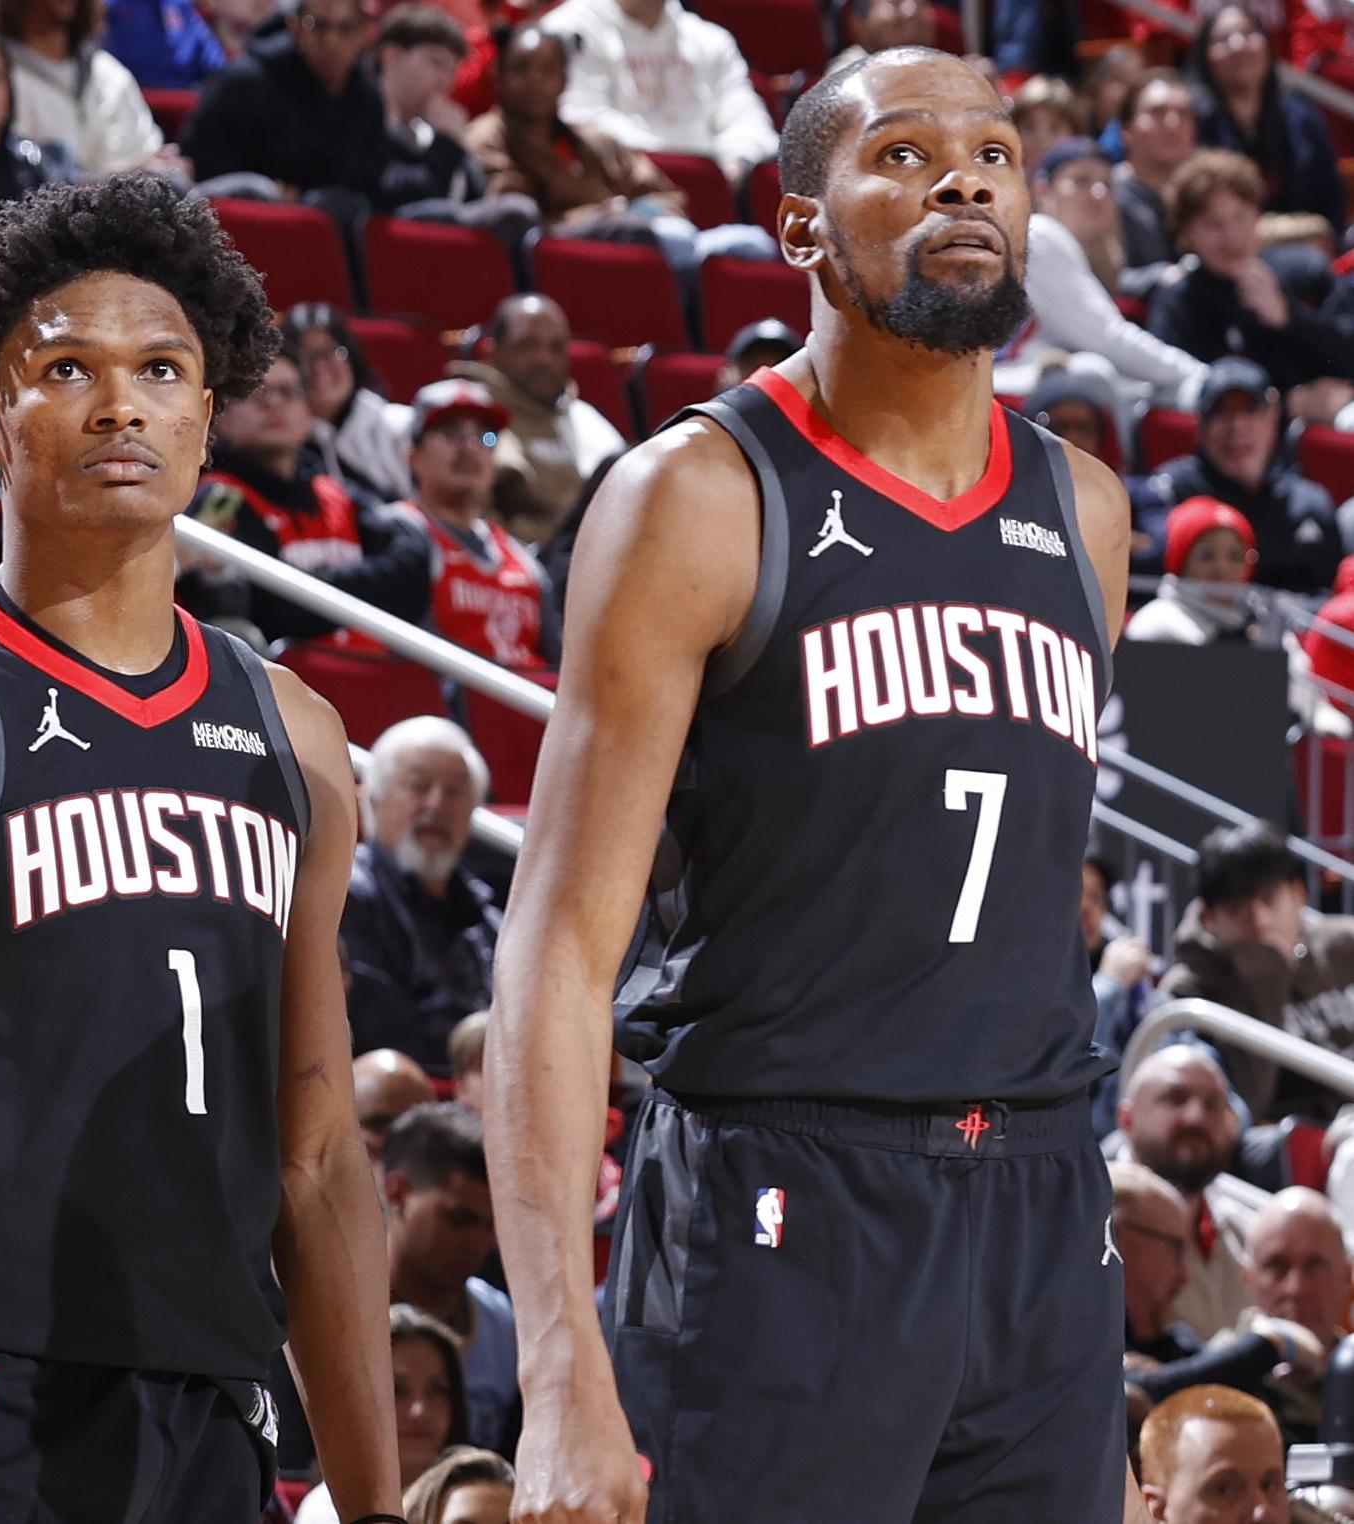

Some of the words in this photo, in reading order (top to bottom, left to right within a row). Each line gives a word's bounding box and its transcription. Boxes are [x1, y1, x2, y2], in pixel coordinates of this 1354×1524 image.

[192, 721, 263, 746] MEMORIAL
[195, 734, 266, 756] HERMANN
[801, 602, 1098, 766] HOUSTON
[5, 788, 299, 942] HOUSTON
[944, 768, 1008, 943] 7
[168, 949, 208, 1115] 1
